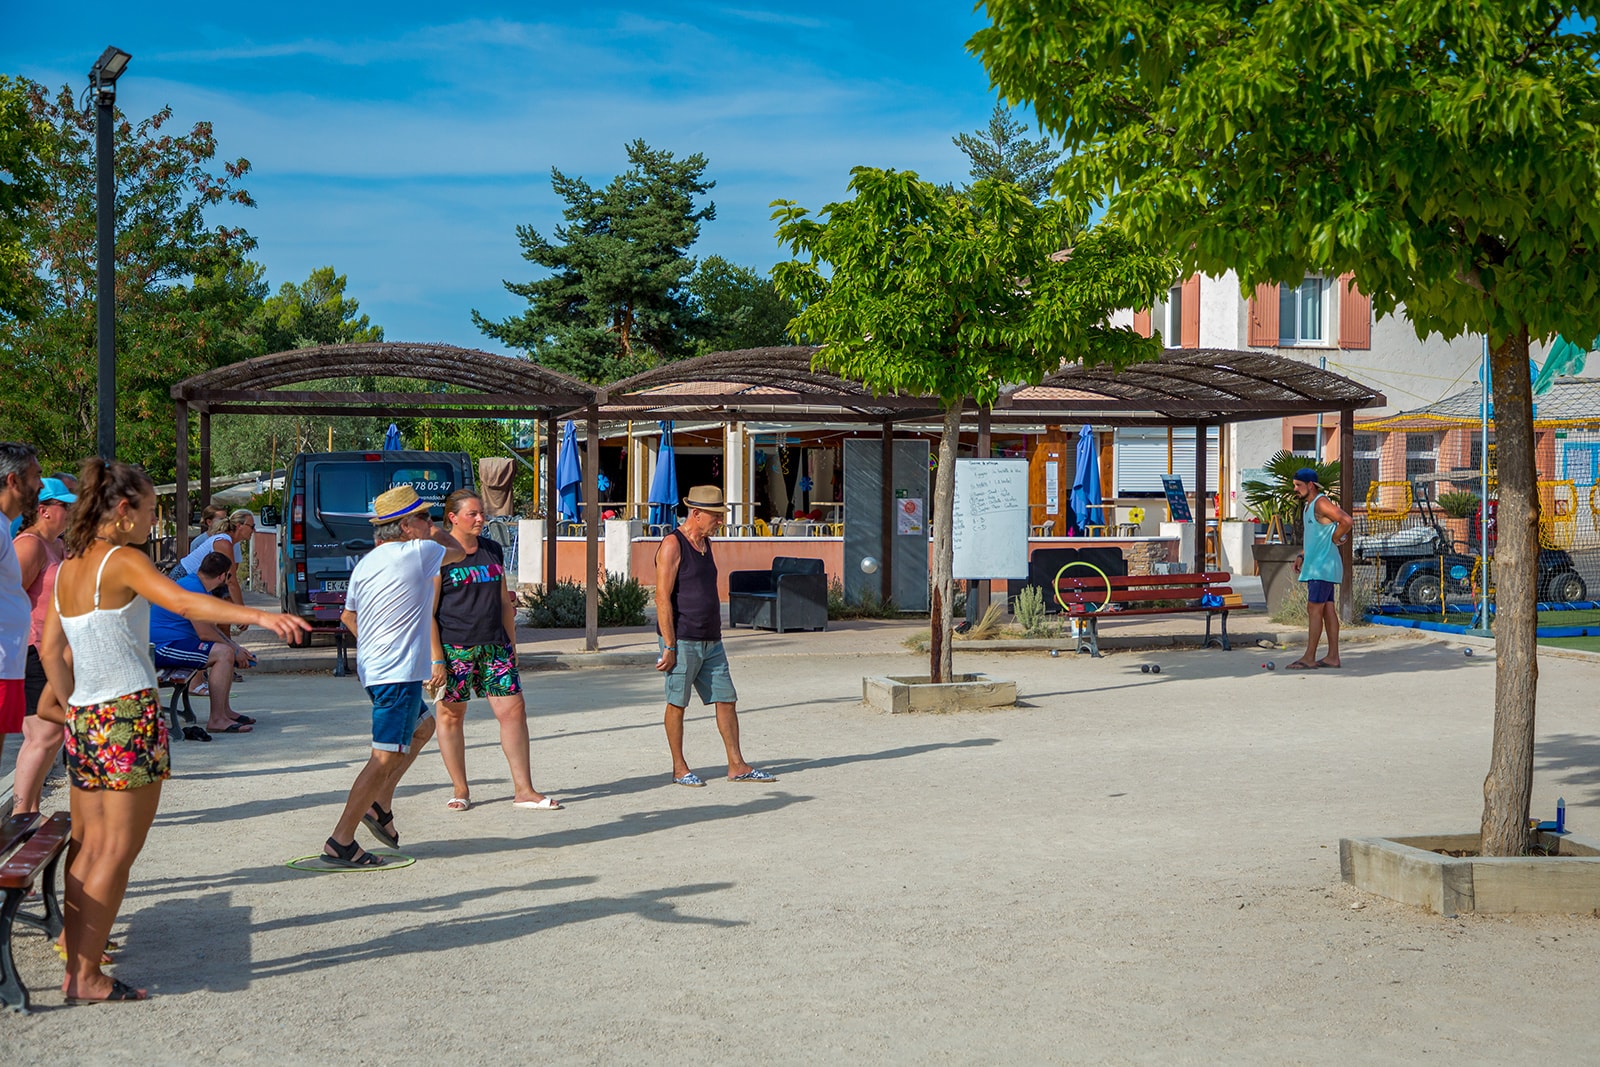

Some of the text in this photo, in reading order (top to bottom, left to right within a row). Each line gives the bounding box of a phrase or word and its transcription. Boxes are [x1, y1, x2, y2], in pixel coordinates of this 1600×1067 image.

[415, 481, 426, 490] 78
[427, 481, 439, 490] 05
[440, 481, 452, 490] 47
